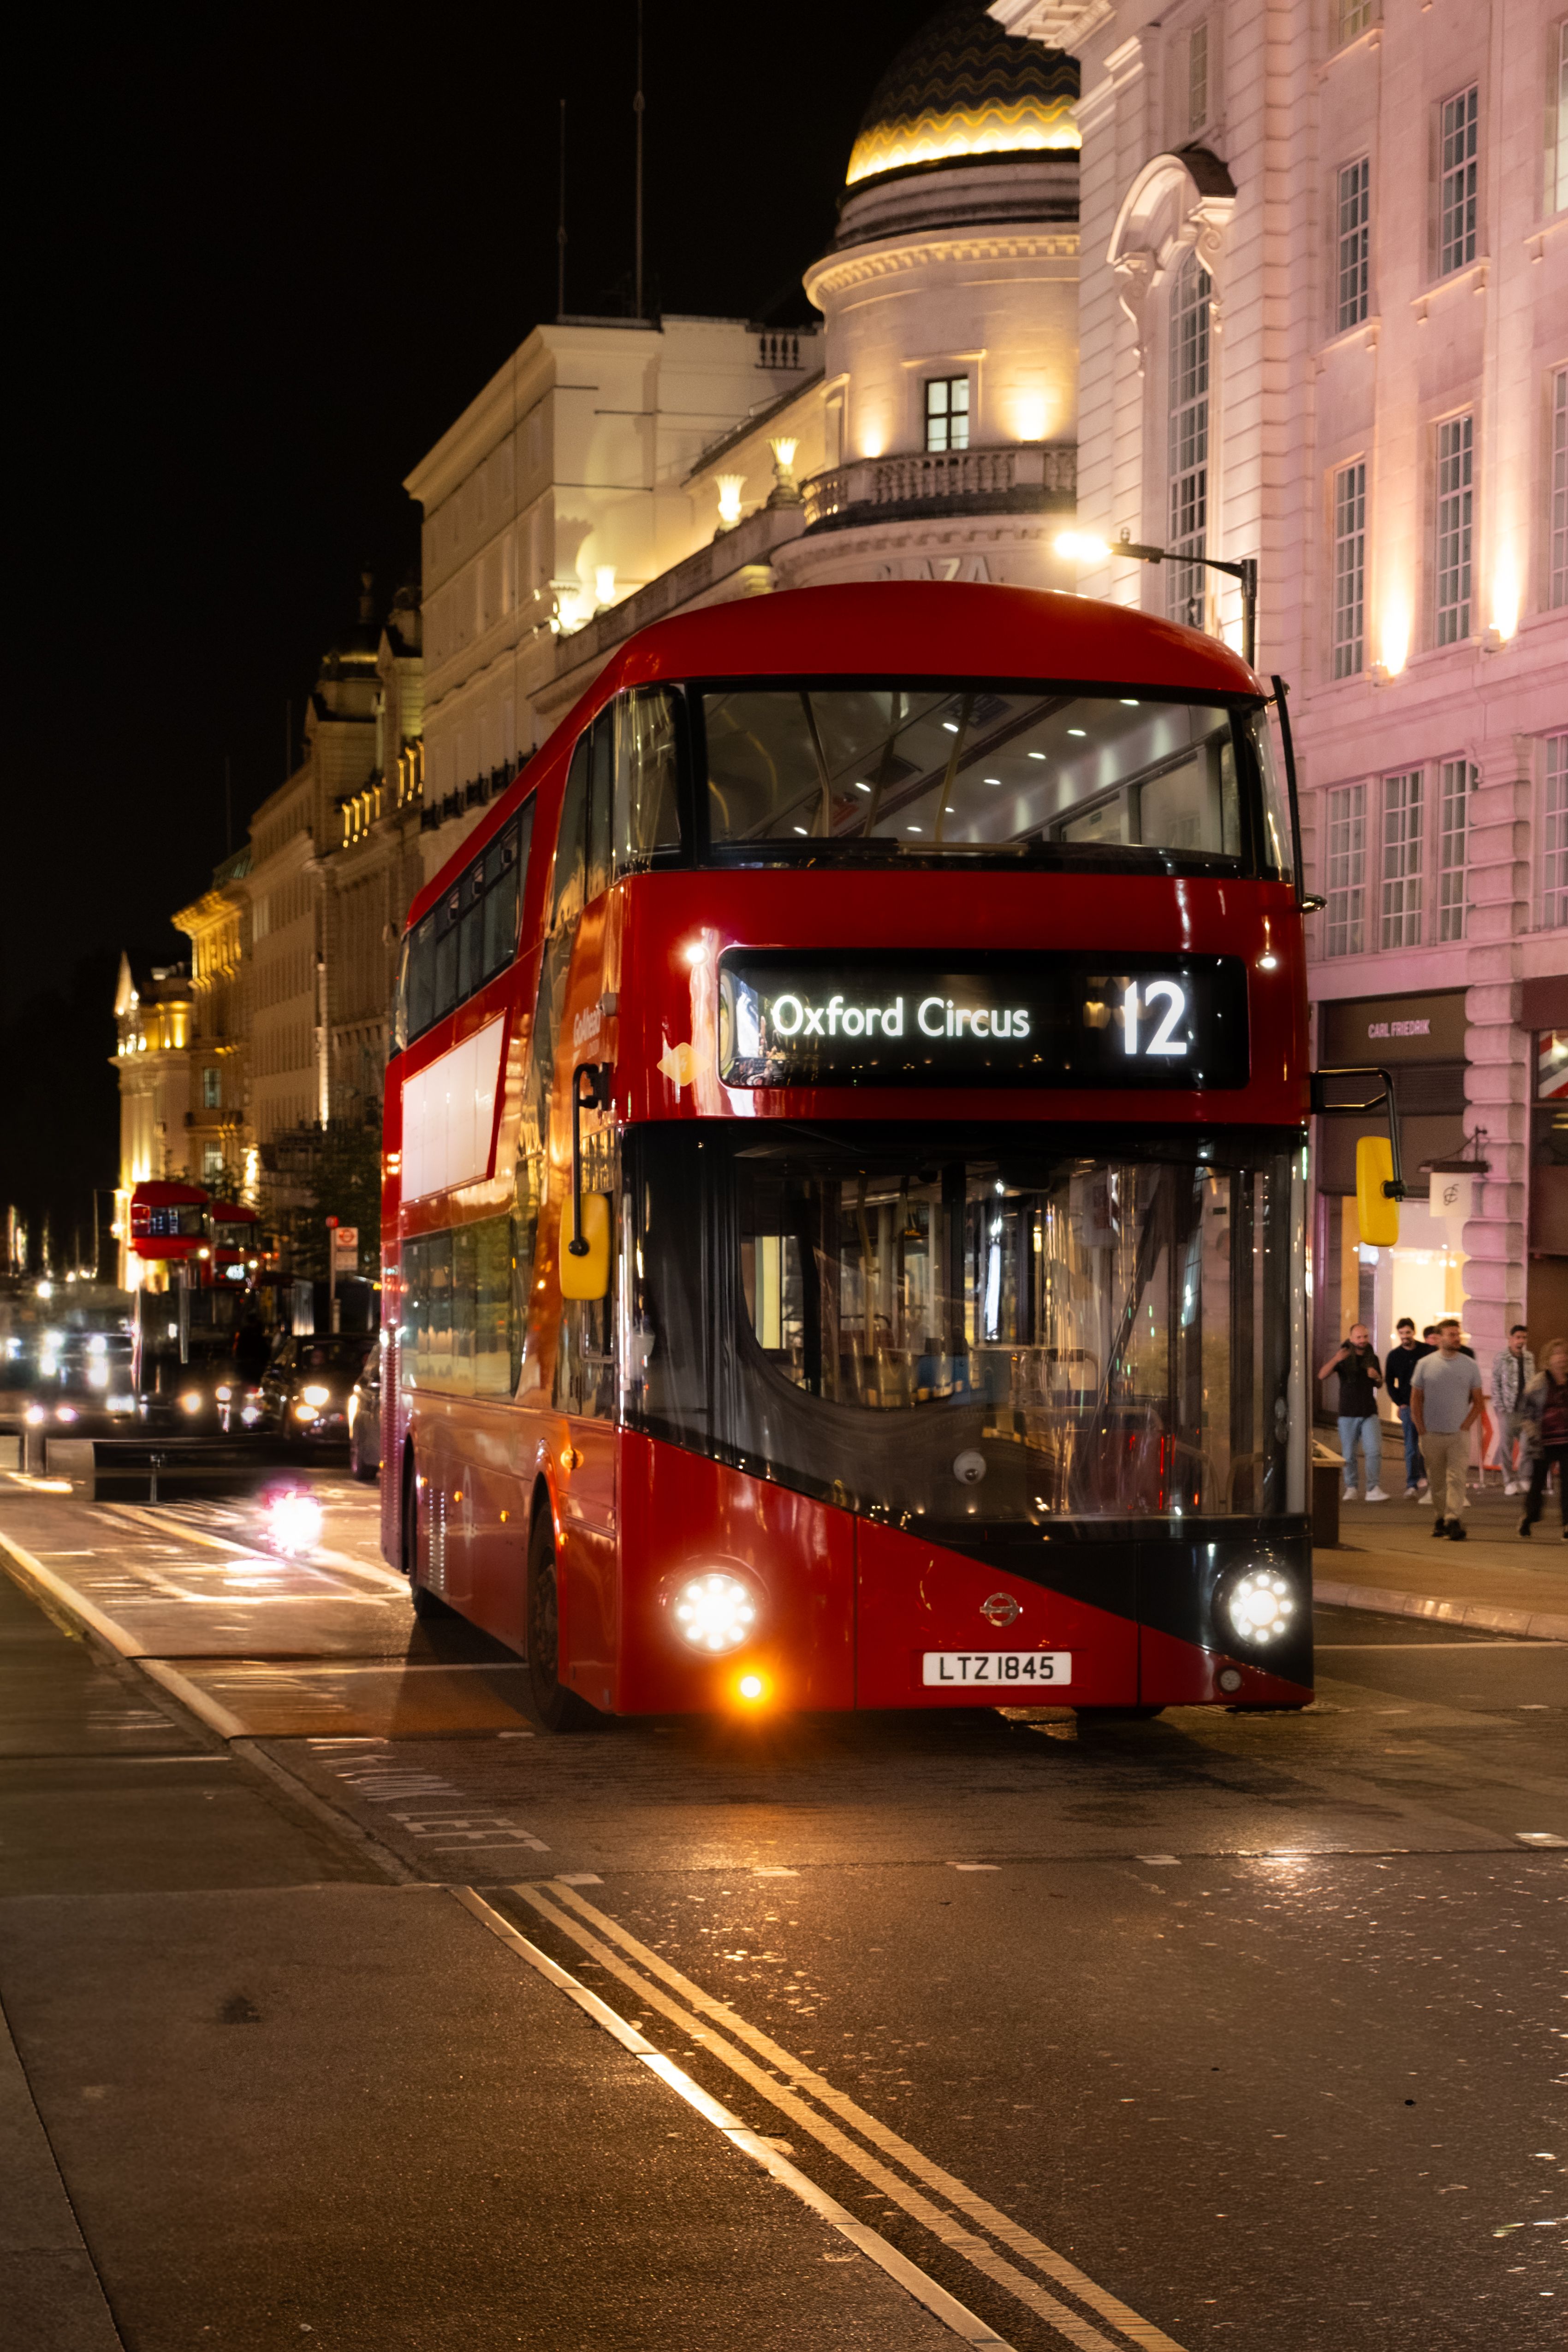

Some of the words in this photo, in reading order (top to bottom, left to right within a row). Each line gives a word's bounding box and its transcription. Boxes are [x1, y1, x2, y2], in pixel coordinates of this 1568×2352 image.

[772, 995, 903, 1037] Oxford
[918, 997, 1030, 1037] Circus
[1121, 980, 1187, 1055] 12
[1368, 1023, 1390, 1039] CARL
[1391, 1019, 1430, 1036] FRIEDRIK
[940, 1657, 989, 1680] LTZ
[998, 1656, 1053, 1680] 1845
[387, 1809, 552, 1852] LEFT
